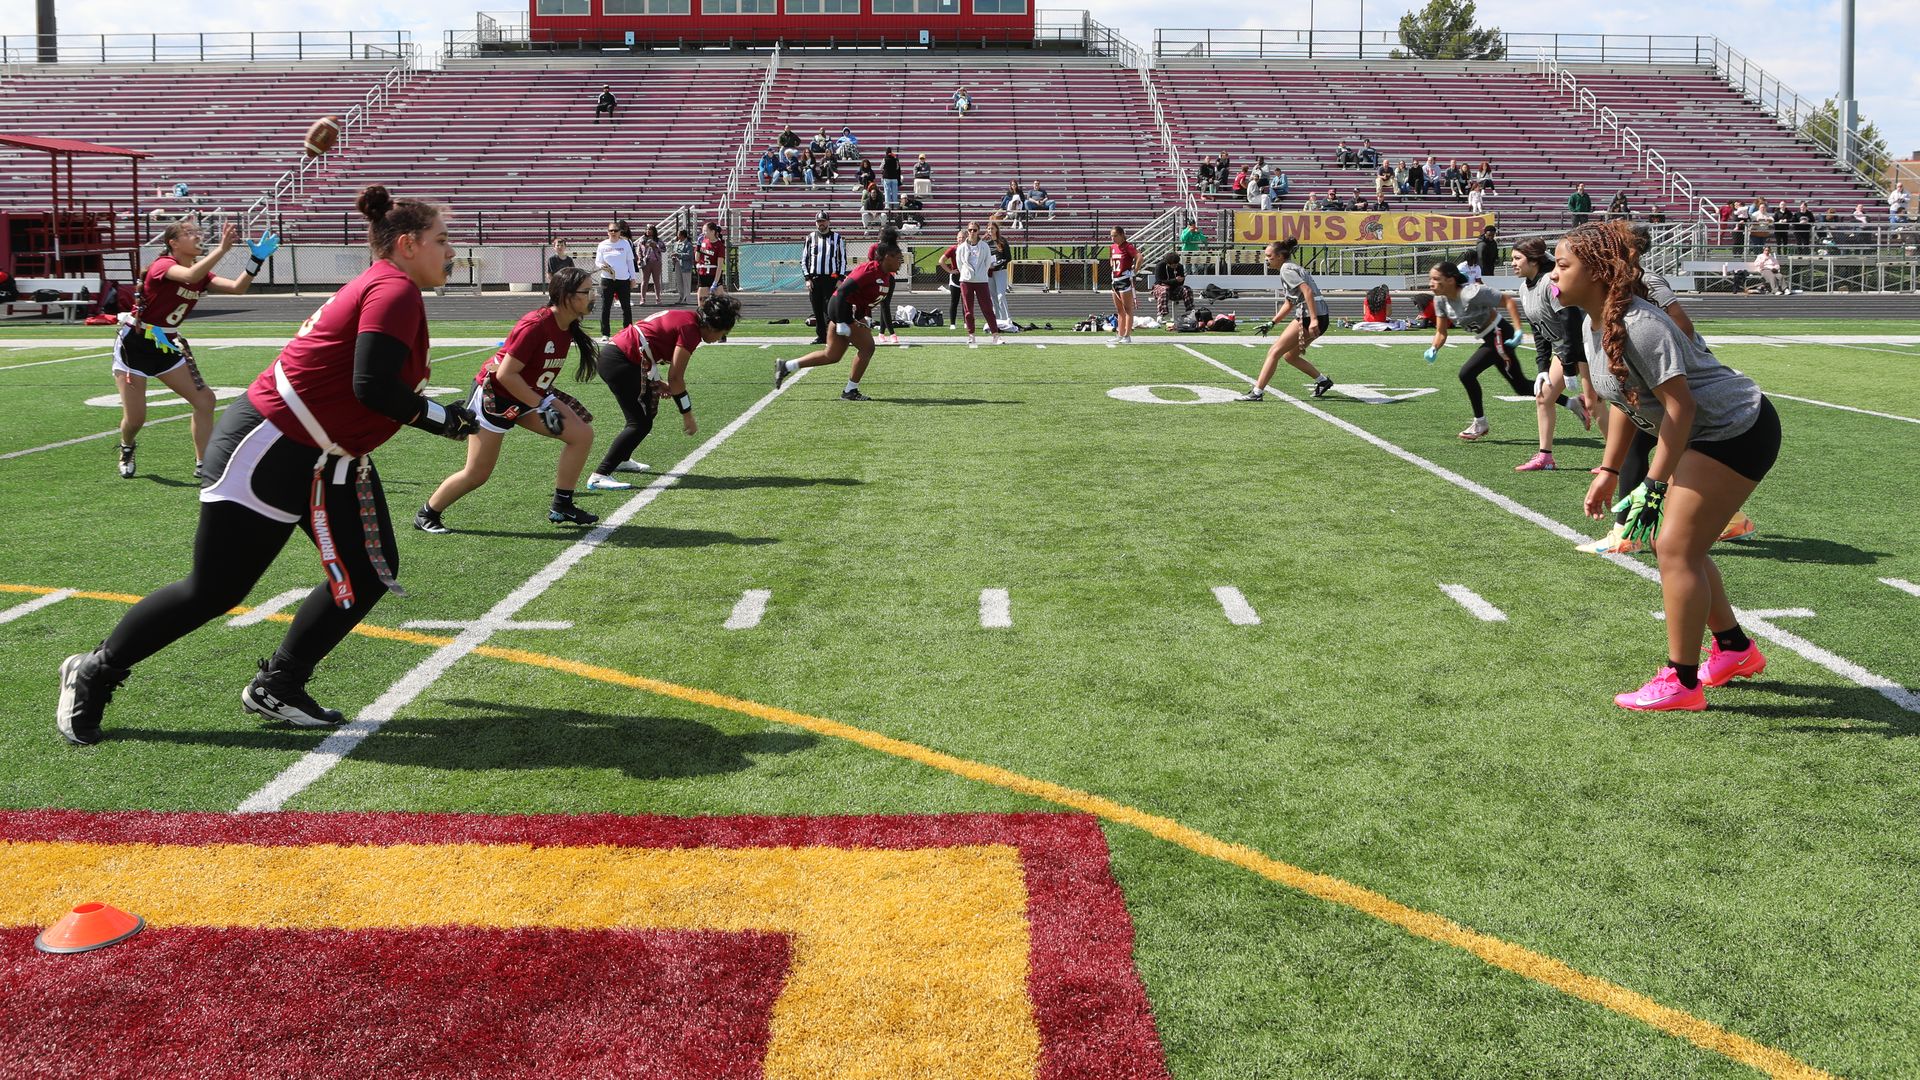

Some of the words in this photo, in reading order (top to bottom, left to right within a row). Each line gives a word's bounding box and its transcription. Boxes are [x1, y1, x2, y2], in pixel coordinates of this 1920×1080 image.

[1242, 214, 1347, 241] JIM'S
[166, 303, 188, 325] 8
[313, 510, 337, 561] BROWNS
